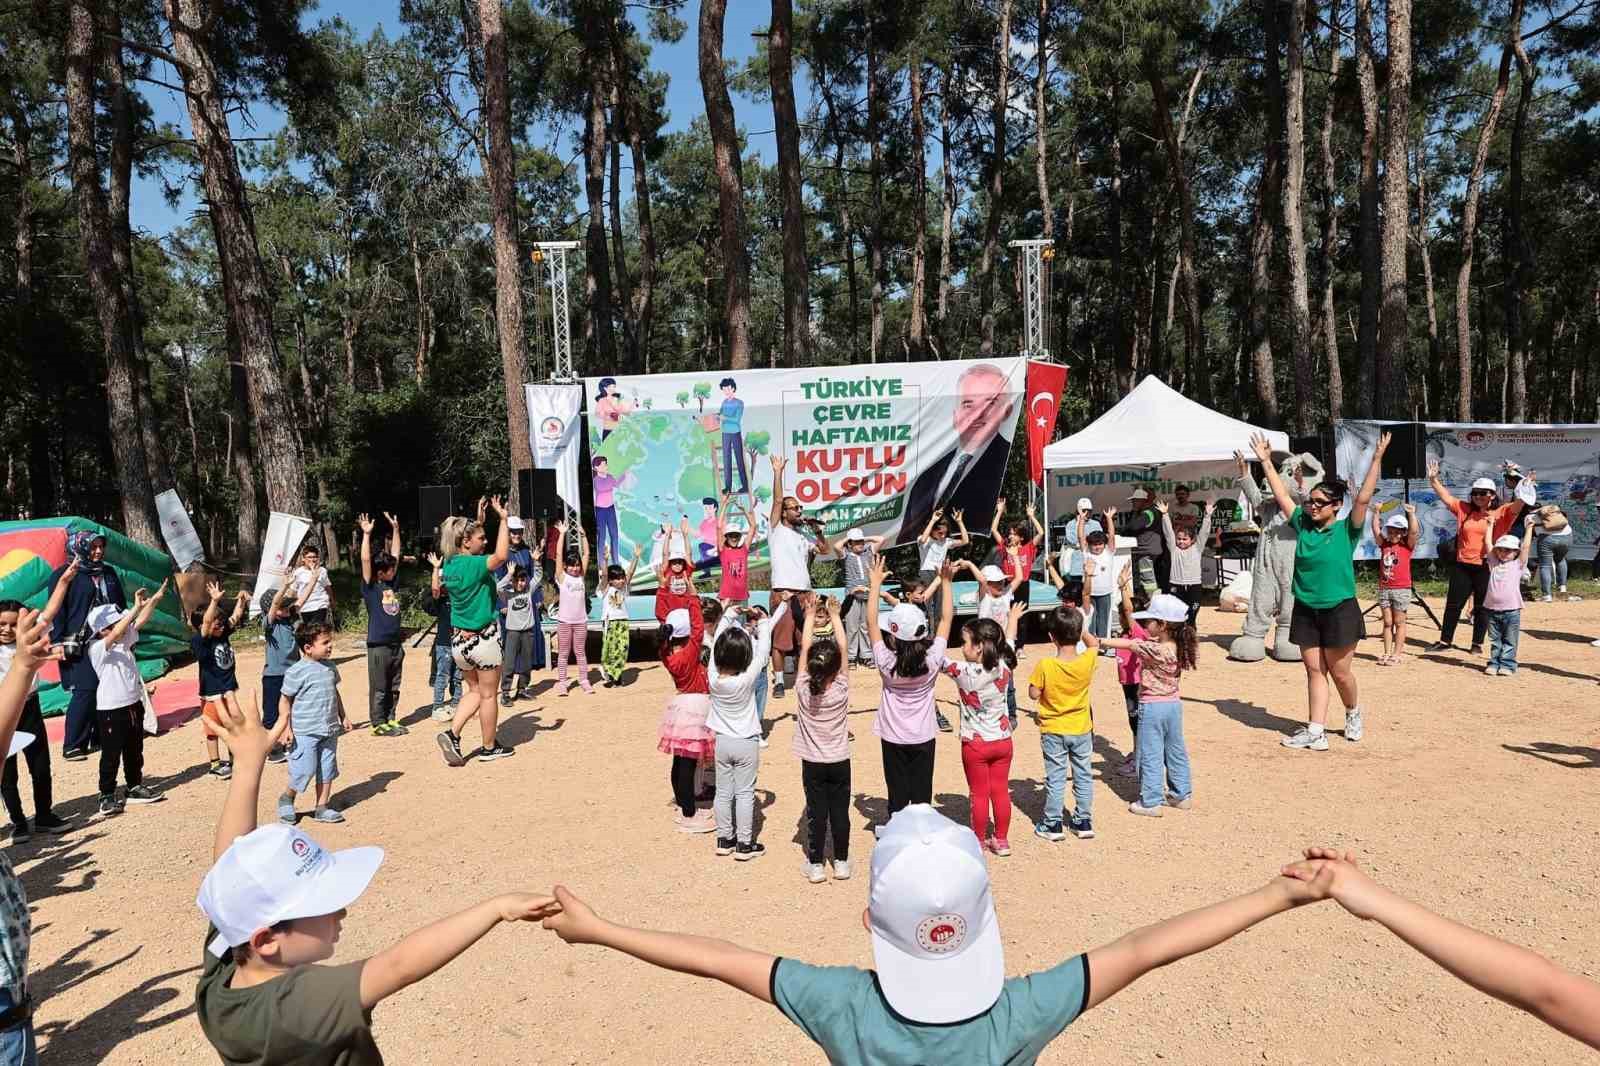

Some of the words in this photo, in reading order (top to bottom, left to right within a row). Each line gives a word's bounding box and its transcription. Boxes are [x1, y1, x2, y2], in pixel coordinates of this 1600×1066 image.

[800, 376, 902, 399] TÜRKİYE
[813, 403, 891, 425] ÇEVRE
[792, 424, 912, 446] HAFTAMIZ
[796, 444, 907, 474] KUTLU
[796, 472, 907, 502] OLSUN
[1056, 469, 1104, 487] TEMİZ
